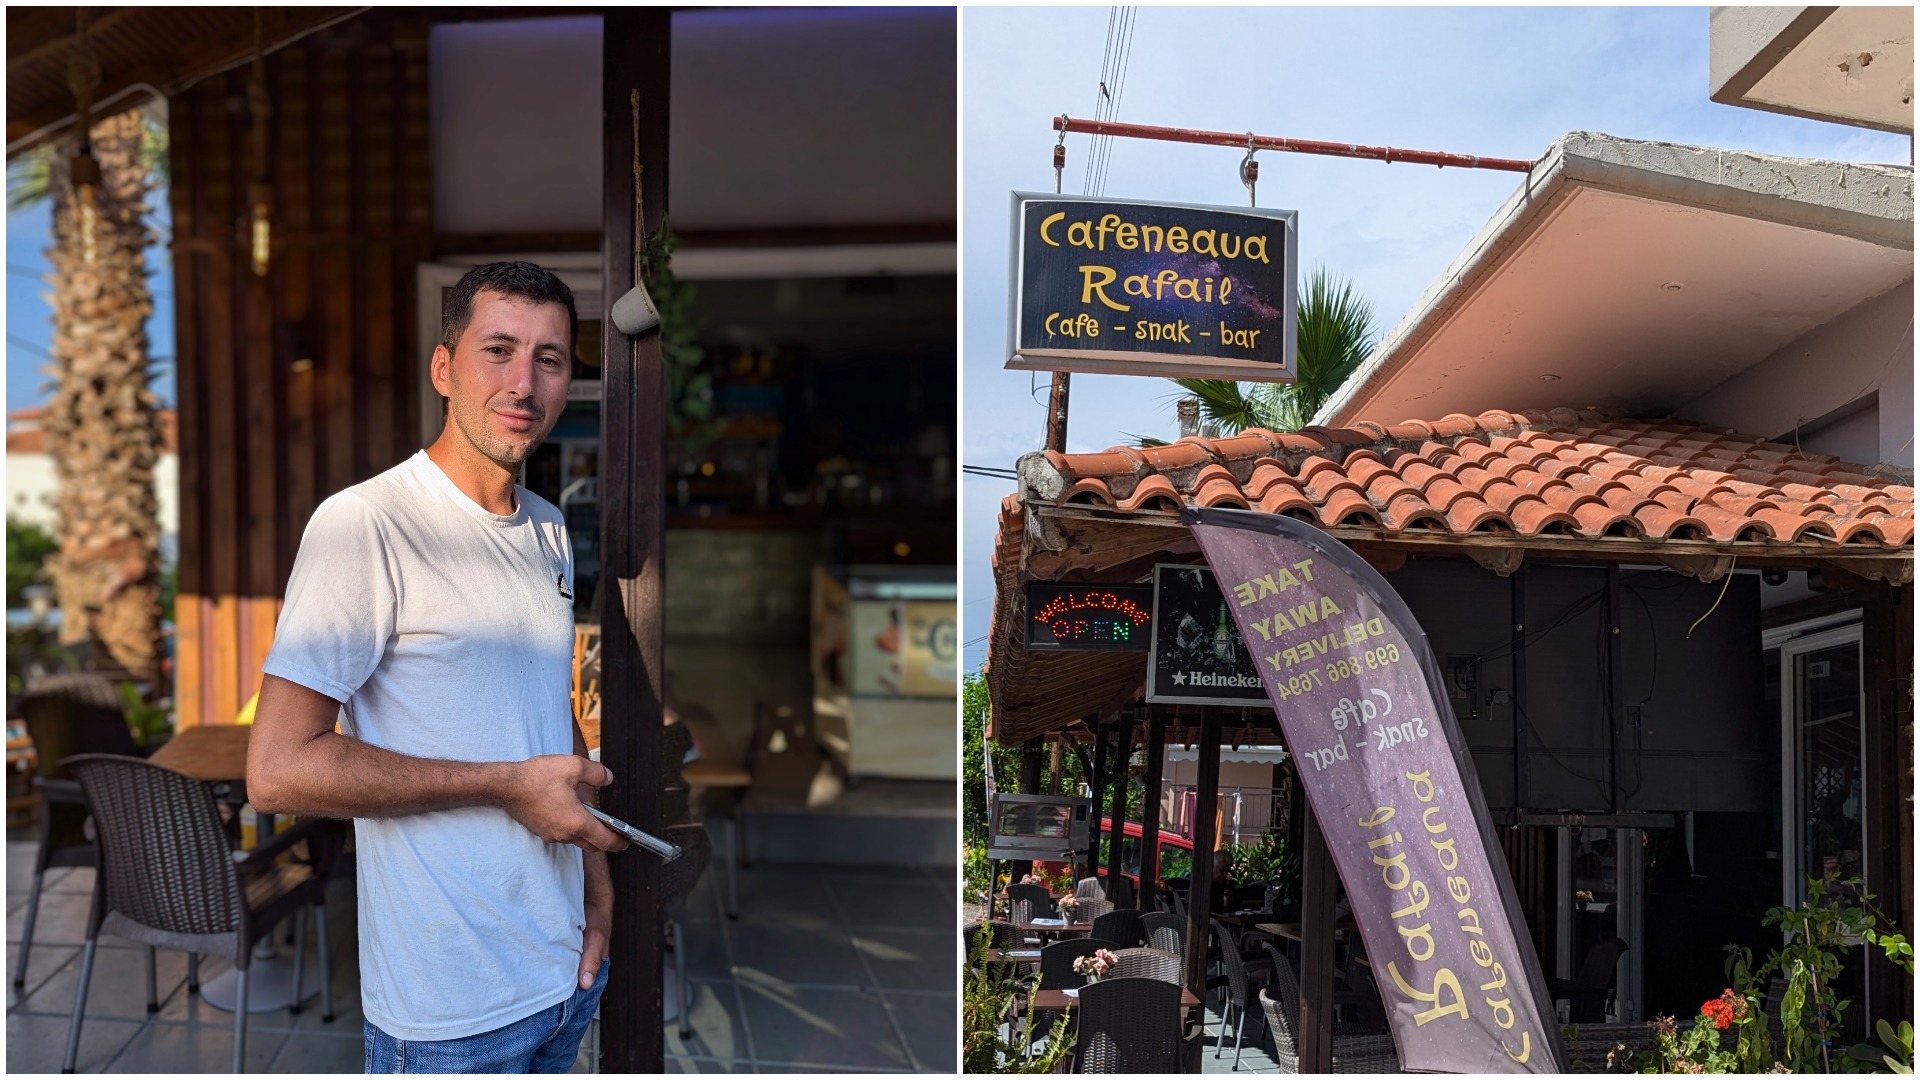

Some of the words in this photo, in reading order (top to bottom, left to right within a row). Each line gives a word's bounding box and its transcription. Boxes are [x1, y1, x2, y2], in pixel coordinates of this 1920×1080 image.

[1040, 211, 1270, 265] Cafeneaua
[1079, 265, 1232, 312] Rafail
[1045, 312, 1100, 338] Cafe
[1135, 319, 1192, 343] snak
[1220, 321, 1261, 349] bar
[1034, 592, 1150, 626] WELCOME
[1052, 619, 1129, 641] OPEN
